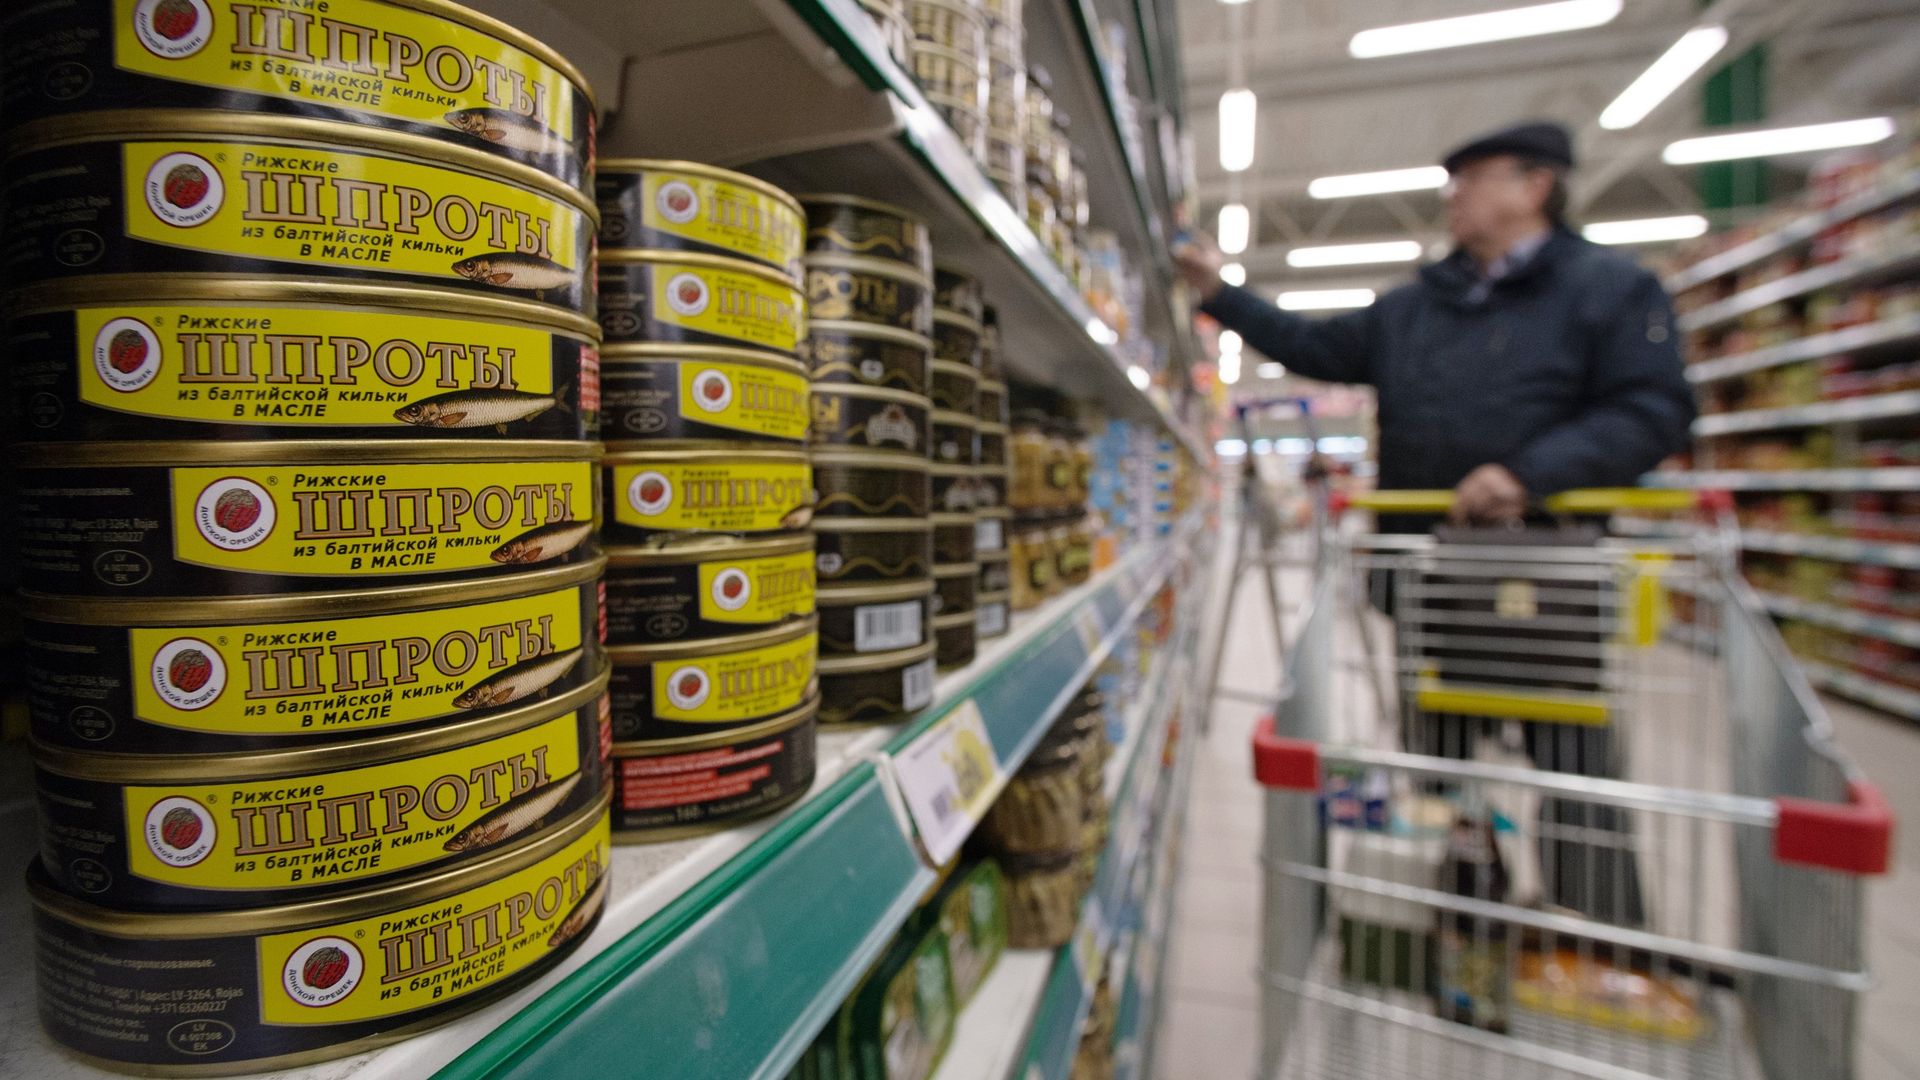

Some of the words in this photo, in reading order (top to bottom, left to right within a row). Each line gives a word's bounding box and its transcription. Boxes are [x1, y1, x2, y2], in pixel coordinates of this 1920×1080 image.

[231, 3, 547, 125] ШПРОТЫ
[230, 60, 253, 71] из
[262, 59, 384, 92] балтийской
[392, 85, 457, 107] кильки
[289, 80, 301, 93] В
[311, 82, 381, 106] МАСЛЕ
[242, 153, 339, 173] Рижские
[241, 171, 552, 260] ШПРОТЫ
[241, 227, 264, 238] из
[274, 226, 394, 247] балтийской
[402, 239, 464, 256] кильки
[300, 244, 312, 256] В
[321, 246, 391, 262] МАСЛЕ
[178, 315, 272, 329] Рижские
[177, 333, 517, 391] ШПРОТЫ
[178, 389, 199, 400] из
[208, 387, 329, 401] балтийской
[338, 390, 408, 402] кильки
[233, 404, 245, 416] В
[254, 404, 326, 417] МАСЛЕ
[293, 474, 387, 487] Рижские
[201, 506, 227, 544] ДОНСКОЙ
[229, 527, 266, 546] ОРЕШЕК
[292, 483, 574, 540] ШПРОТЫ
[294, 546, 316, 557] из
[325, 536, 438, 556] балтийской
[445, 535, 501, 548] кильки
[351, 556, 362, 570] В
[371, 552, 436, 569] МАСЛЕ
[244, 630, 337, 647] Рижские
[242, 614, 554, 700] ШПРОТЫ
[244, 705, 267, 716] из
[276, 689, 393, 714] балтийской
[401, 680, 464, 700] кильки
[302, 714, 314, 728] В
[322, 705, 391, 725] МАСЛЕ
[231, 744, 549, 857] ШПРОТЫ
[232, 785, 325, 804] Рижские
[234, 861, 256, 872] из
[265, 839, 383, 869] балтийской
[391, 823, 455, 848] кильки
[291, 869, 302, 881] В
[312, 855, 381, 879] МАСЛЕ
[379, 840, 602, 985] ШПРОТЫ
[379, 903, 463, 936] Рижские
[380, 986, 402, 1001] из
[409, 945, 507, 991] балтийской
[512, 920, 556, 952] кильки
[288, 968, 315, 1002] ДОНСКОЙ
[318, 979, 354, 1002] ОРЕШЕК
[432, 985, 443, 999] В
[450, 960, 506, 993] МАСЛЕ
